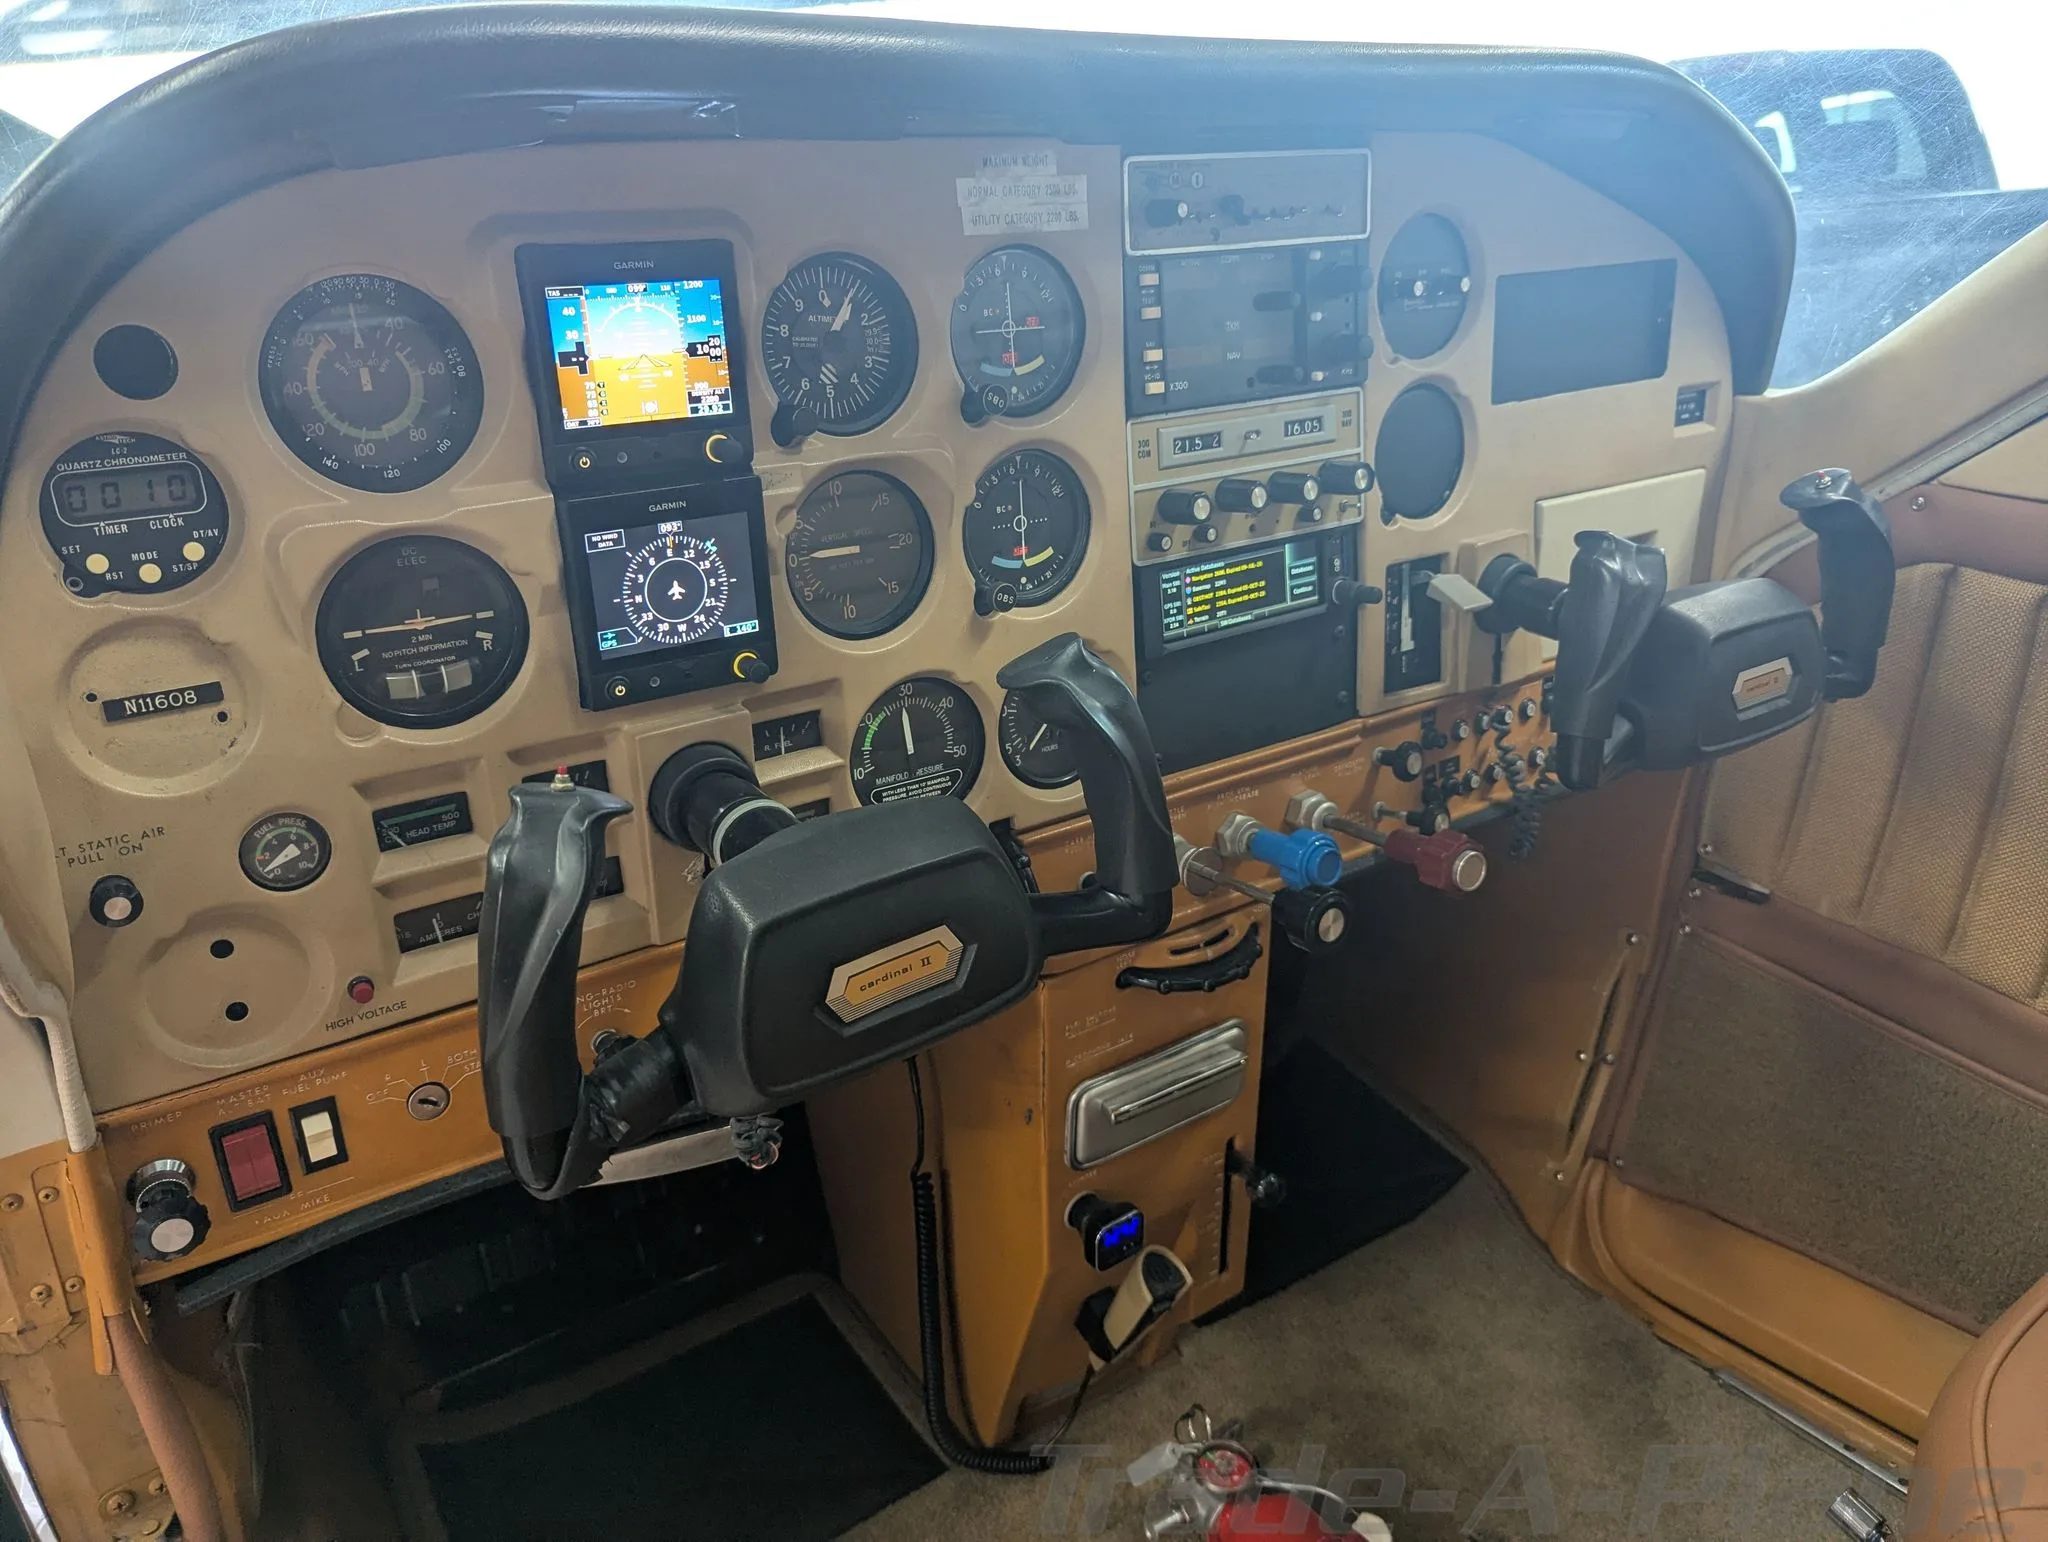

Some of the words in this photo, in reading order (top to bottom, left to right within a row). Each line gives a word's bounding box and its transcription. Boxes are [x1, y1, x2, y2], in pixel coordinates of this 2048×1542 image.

[1022, 154, 1048, 168] WEIGHT
[967, 185, 998, 198] NORMAL
[1002, 184, 1041, 198] CATEGORY
[1005, 212, 1042, 225] CATEGORY
[613, 260, 654, 270] GARMIN
[683, 281, 703, 289] 1200
[562, 307, 576, 316] 40
[795, 299, 804, 312] 9
[687, 314, 706, 323] 1100
[983, 308, 993, 317] BC
[385, 317, 404, 331] 40
[861, 313, 869, 326] 2
[565, 331, 579, 340] 30
[780, 324, 789, 337] 8
[708, 337, 721, 346] 20
[782, 356, 791, 369] 7
[864, 356, 873, 368] 3
[427, 363, 445, 376] 60
[801, 378, 810, 391] 6
[850, 373, 859, 385] 4
[826, 385, 835, 398] 5
[1287, 420, 1320, 435] 16.05
[408, 428, 428, 442] 80
[354, 443, 376, 457] 100
[436, 438, 453, 455] 100
[1175, 437, 1202, 453] 21.5
[56, 459, 101, 472] QUARTZ
[105, 452, 188, 467] CHRONOMETER
[321, 456, 340, 471] 140
[383, 468, 401, 479] 120
[829, 480, 842, 496] 10
[648, 500, 687, 512] GARMIN
[877, 494, 890, 507] 15
[996, 505, 1006, 514] BC
[93, 523, 129, 536] TIMER
[149, 517, 185, 530] CLOCK
[192, 528, 220, 539] DT/AV
[821, 532, 848, 543] VERTICAL
[899, 532, 913, 546] 20
[61, 544, 81, 555] SET
[598, 540, 614, 548] DATA
[131, 551, 159, 562] MODE
[402, 547, 417, 556] DC
[666, 549, 673, 557] E
[683, 549, 695, 559] 12
[172, 563, 198, 573] ST/SP
[397, 556, 427, 567] ELEC
[649, 558, 656, 566] 6
[699, 560, 711, 570] 15
[789, 555, 798, 568] 0
[105, 571, 125, 582] RST
[637, 575, 644, 583] 3
[709, 579, 716, 587] S
[804, 587, 814, 601] 5
[887, 581, 899, 594] 15
[635, 595, 643, 603] N
[705, 598, 716, 606] 21
[996, 592, 1015, 604] OBS
[641, 612, 654, 621] 33
[844, 604, 857, 620] 10
[693, 614, 706, 624] 24
[657, 623, 670, 632] 30
[677, 623, 687, 632] W
[418, 634, 433, 642] MIN
[602, 639, 617, 648] GPS
[382, 651, 393, 660] NO
[394, 646, 417, 657] PITCH
[418, 639, 468, 654] INFORMATION
[482, 640, 493, 652] R
[354, 661, 364, 672] L
[899, 682, 913, 697] 30
[123, 690, 198, 716] N11608
[938, 696, 954, 709] 40
[953, 744, 967, 757] 50
[1005, 742, 1013, 755] 5
[1042, 743, 1059, 753] HOURS
[1014, 754, 1022, 767] 3
[854, 768, 865, 781] 10
[875, 771, 909, 785] MANIFOLD
[927, 776, 950, 785] MANIFOLD
[909, 788, 922, 796] AVOID
[923, 781, 952, 792] CONTINUOUS
[254, 822, 275, 838] FUEL
[278, 818, 307, 828] PRESS
[406, 826, 430, 838] HEAD
[432, 820, 457, 832] TEMP
[78, 833, 130, 854] STATIC
[141, 825, 166, 841] AIR
[304, 842, 310, 851] 8
[67, 852, 104, 868] PULL
[119, 842, 144, 857] ON
[299, 861, 308, 869] 10
[859, 964, 913, 992] cardinal
[920, 956, 932, 968] II
[582, 993, 622, 1012] LIGHTS
[325, 1016, 354, 1032] HIGH
[357, 1000, 408, 1023] VOLTAGE
[593, 1004, 613, 1017] BRT
[447, 1048, 480, 1065] BOTH
[299, 1067, 325, 1082] AUX
[281, 1082, 312, 1097] FUEL
[314, 1070, 349, 1087] PUMP
[216, 1085, 270, 1106] MASTER
[299, 1190, 331, 1212] MIKE
